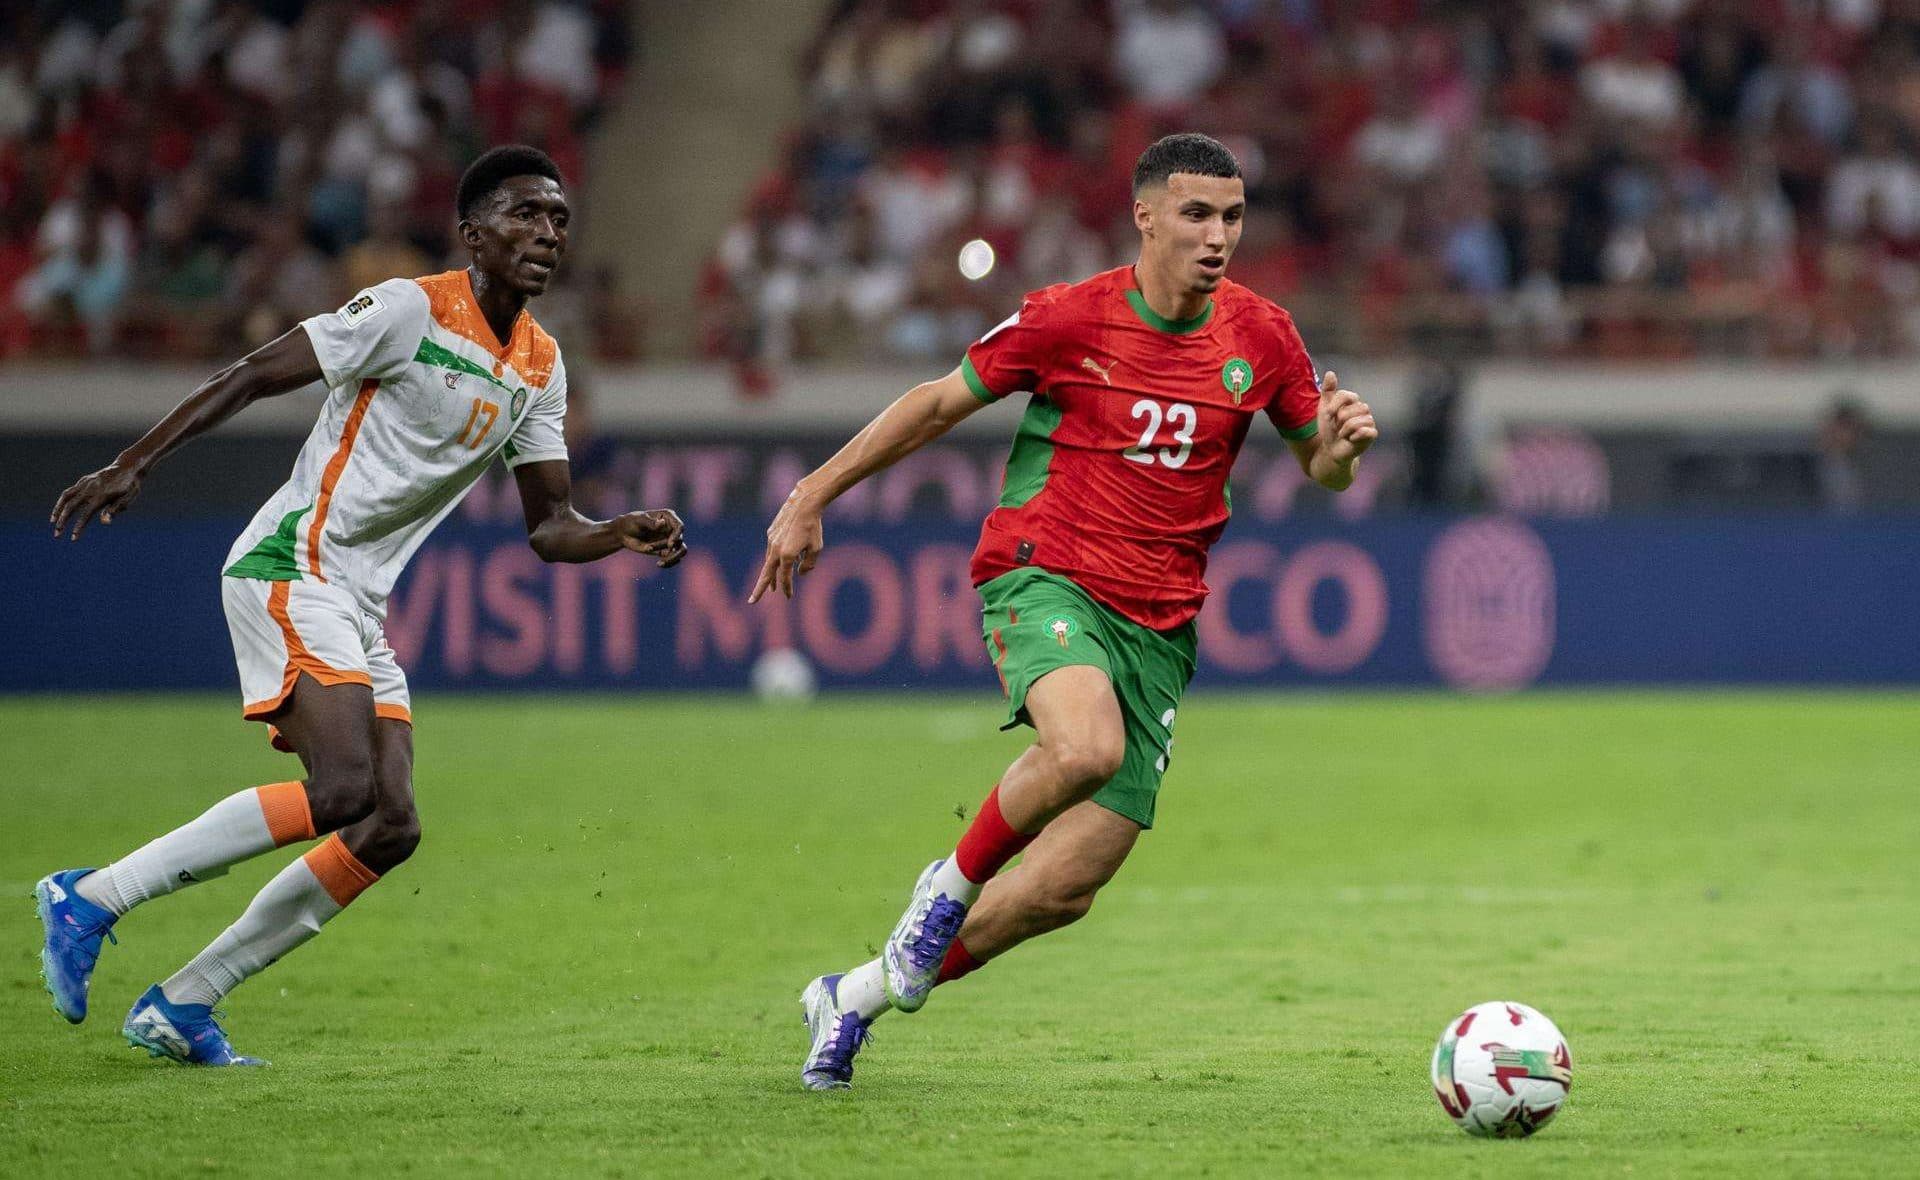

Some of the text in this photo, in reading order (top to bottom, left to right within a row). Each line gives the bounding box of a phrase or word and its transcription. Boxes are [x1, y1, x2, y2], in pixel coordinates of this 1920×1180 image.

[456, 397, 500, 450] 17
[1122, 399, 1198, 470] 23
[384, 541, 1388, 676] VISIT MORCO
